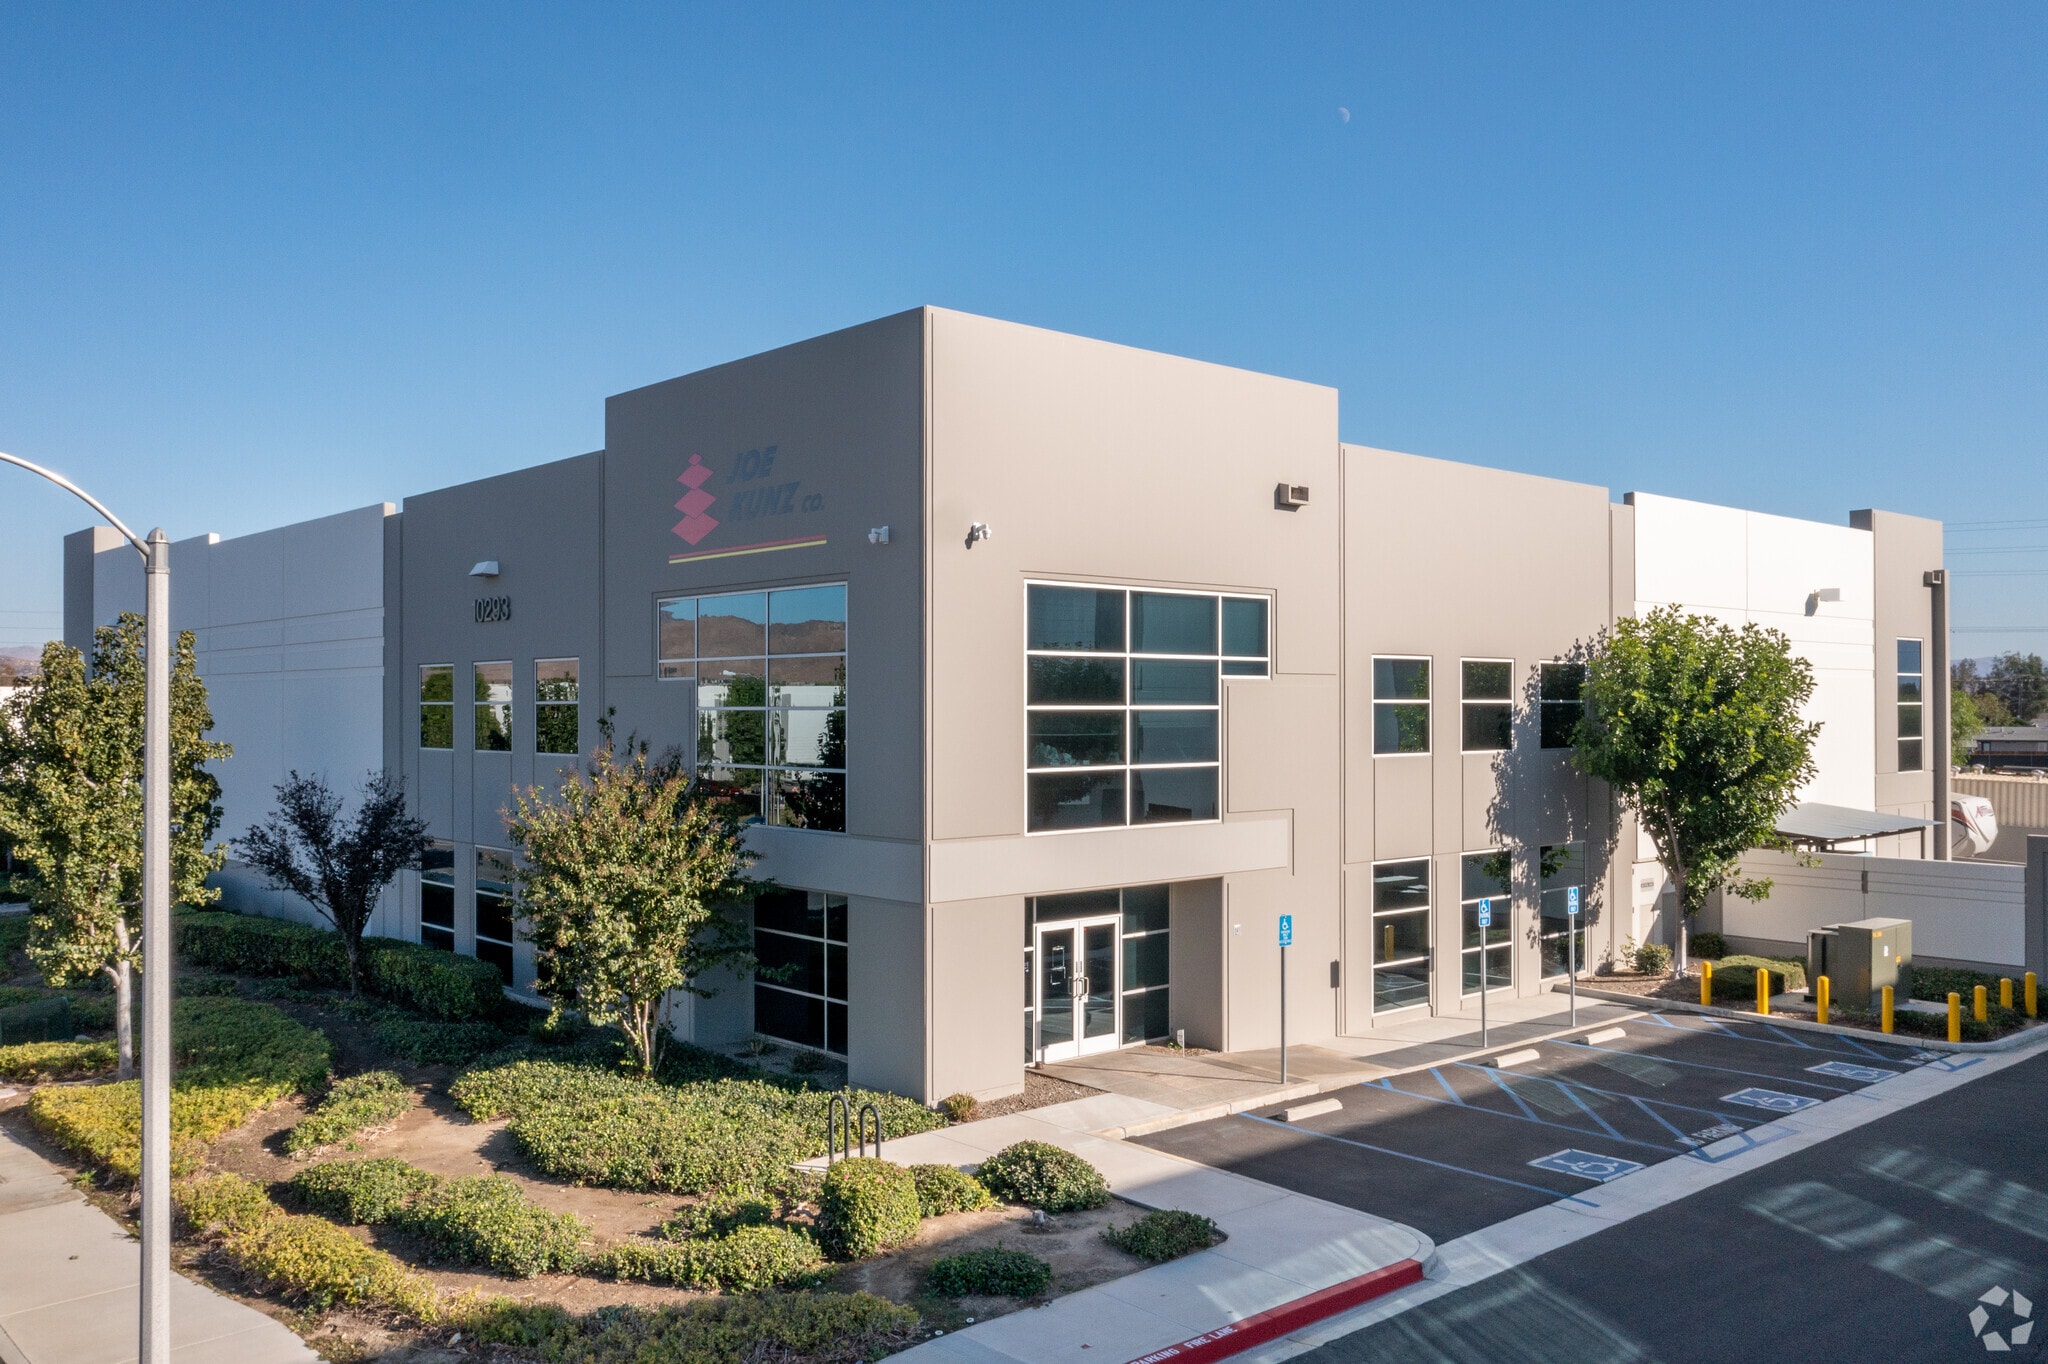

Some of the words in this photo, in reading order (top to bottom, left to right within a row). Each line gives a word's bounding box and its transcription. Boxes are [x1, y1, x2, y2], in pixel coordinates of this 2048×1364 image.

[726, 445, 778, 485] JOE
[728, 481, 801, 522] KUNZ
[472, 596, 511, 623] 10293
[1183, 1336, 1212, 1349] FIRE
[1209, 1326, 1238, 1340] LANE
